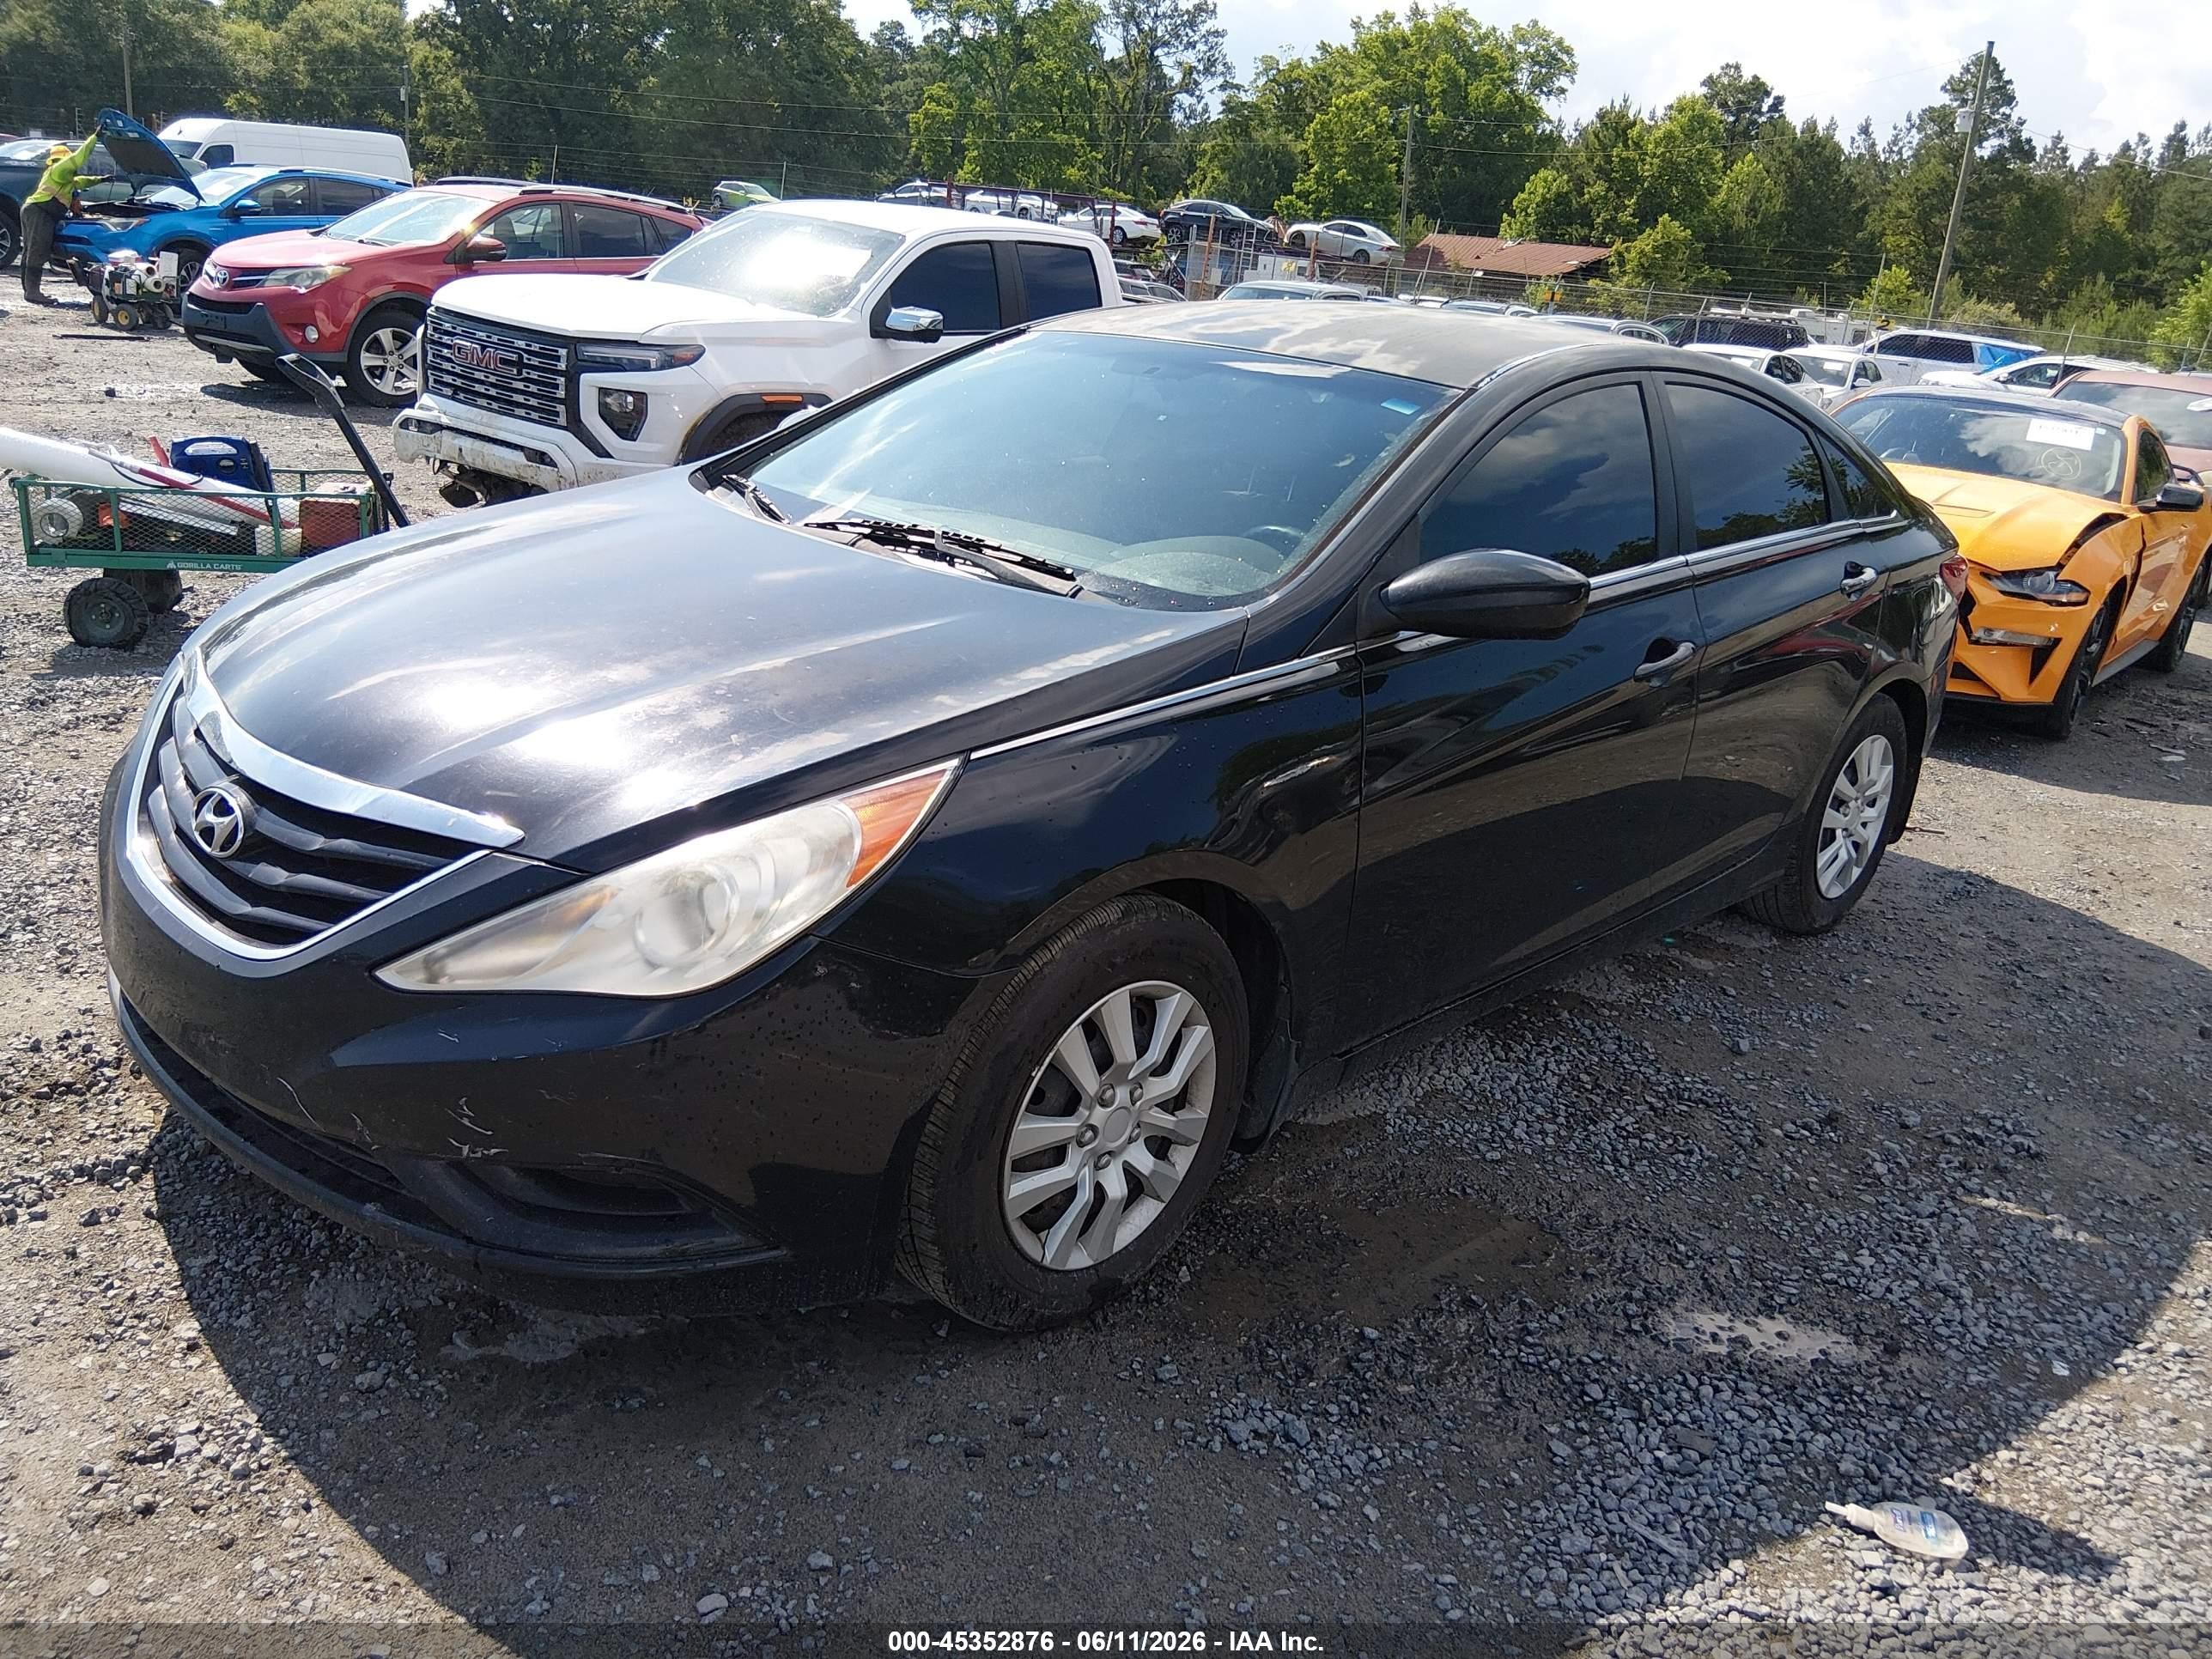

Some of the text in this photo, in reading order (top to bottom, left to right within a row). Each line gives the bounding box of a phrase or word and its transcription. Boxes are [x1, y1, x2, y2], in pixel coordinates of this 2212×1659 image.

[1875, 319, 1891, 331] 2
[453, 340, 520, 376] GMC
[177, 562, 212, 570] GORILLA
